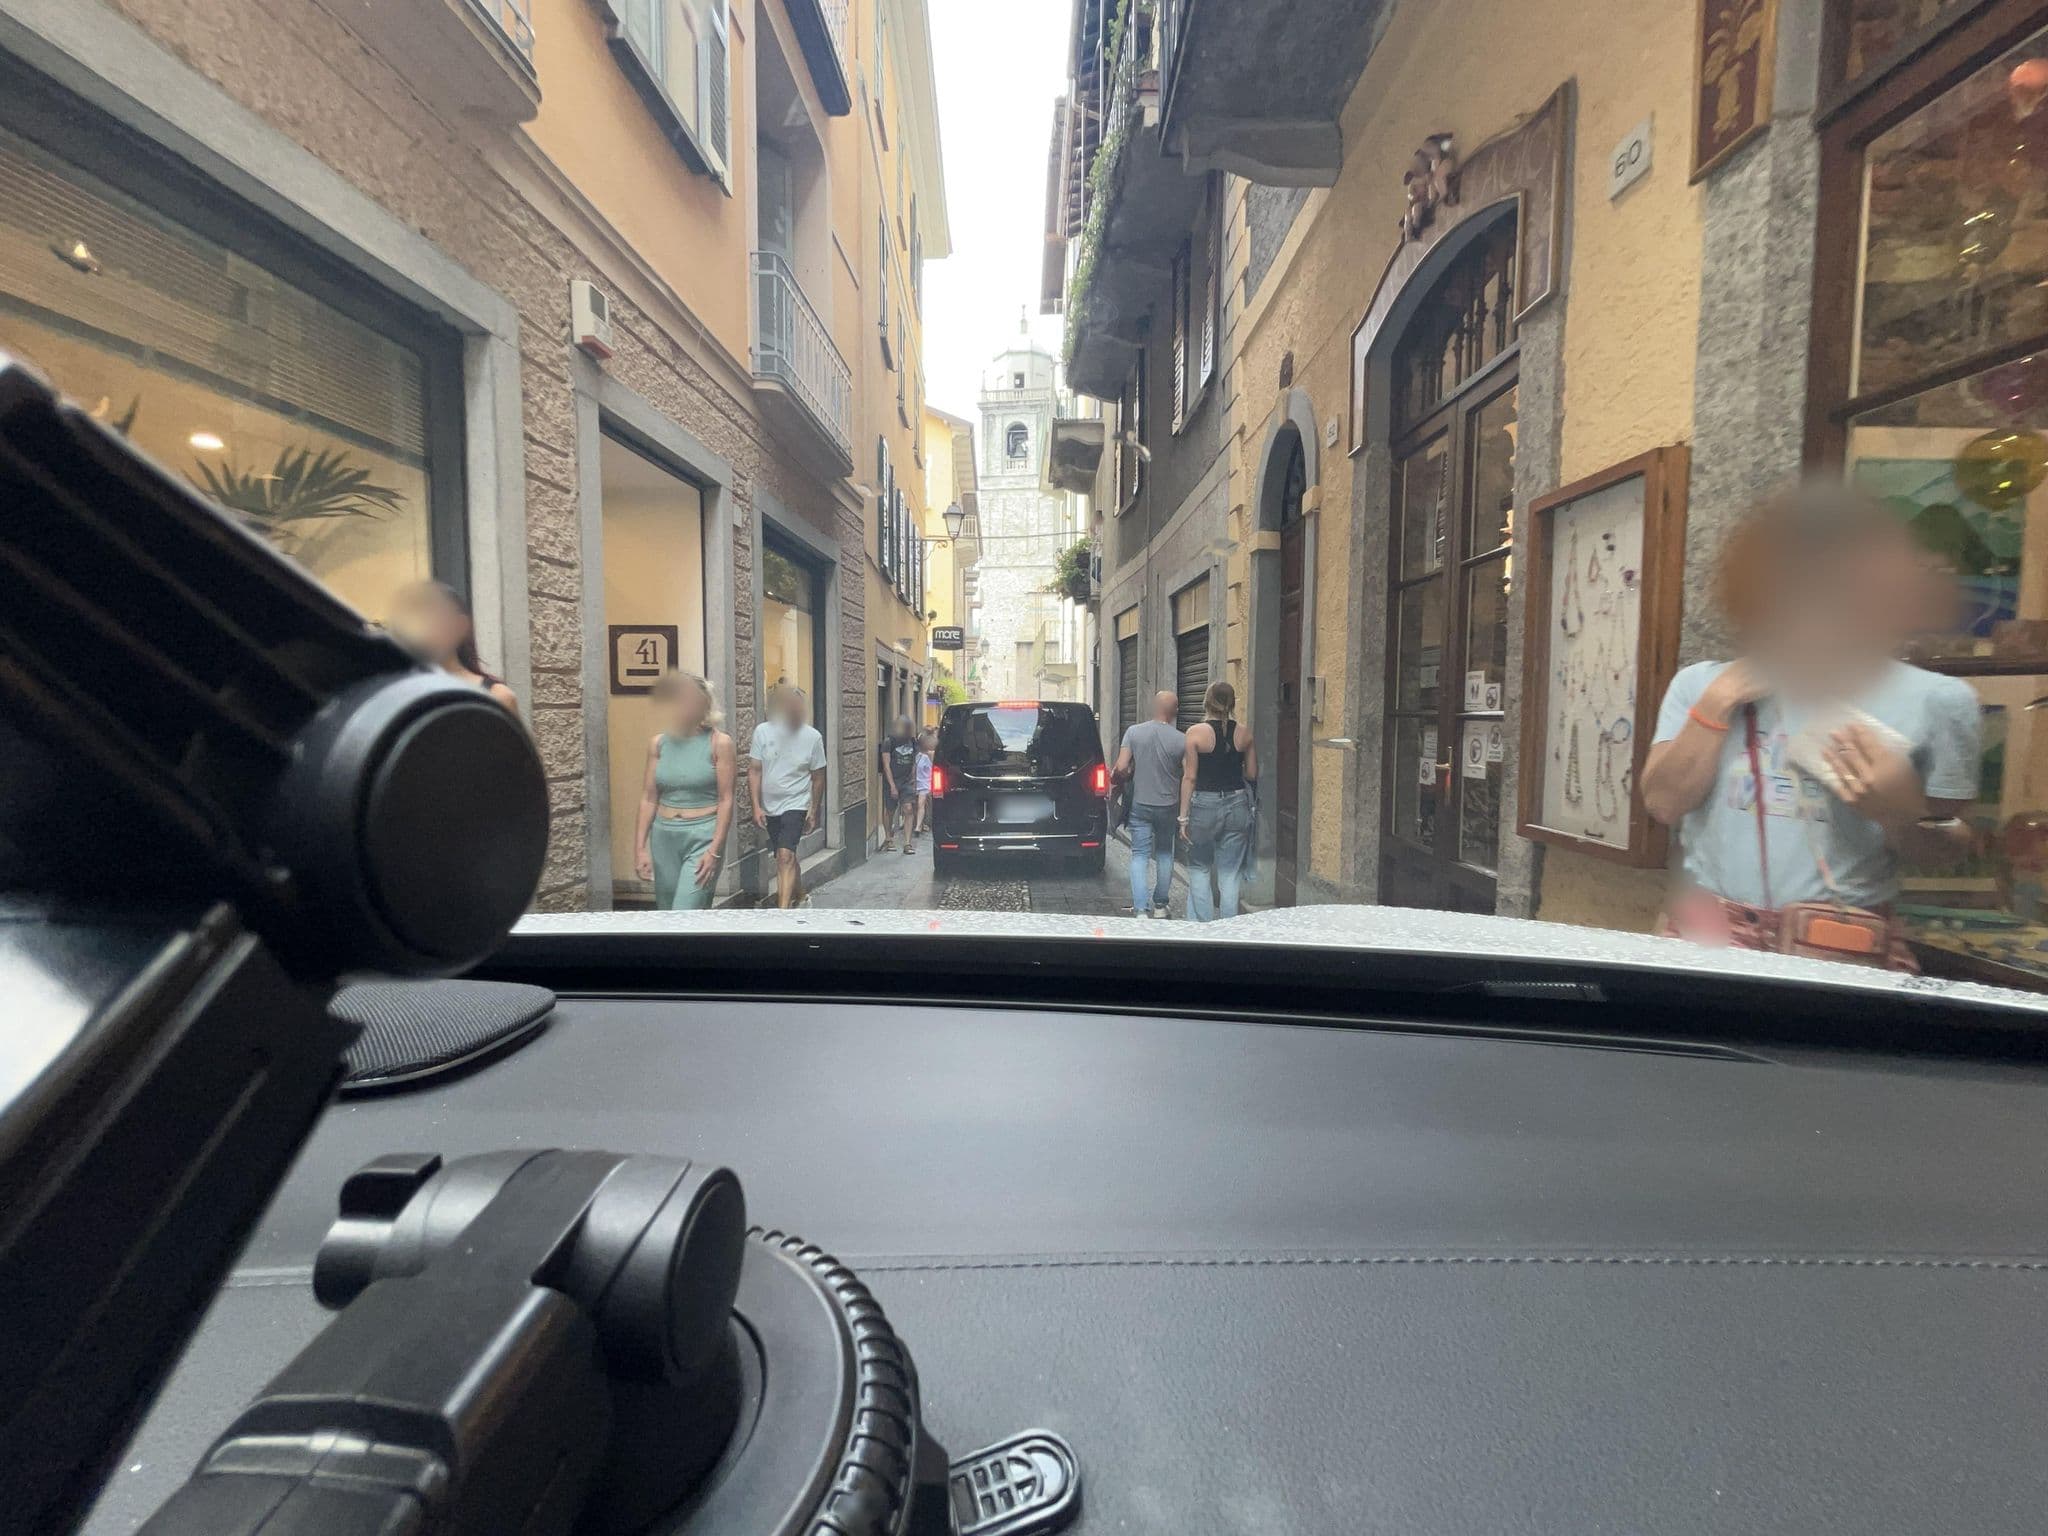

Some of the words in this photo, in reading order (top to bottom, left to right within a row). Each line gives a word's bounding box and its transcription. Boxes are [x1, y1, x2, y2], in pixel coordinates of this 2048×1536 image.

[1615, 139, 1642, 178] 60
[935, 630, 961, 640] more
[635, 638, 659, 665] 41
